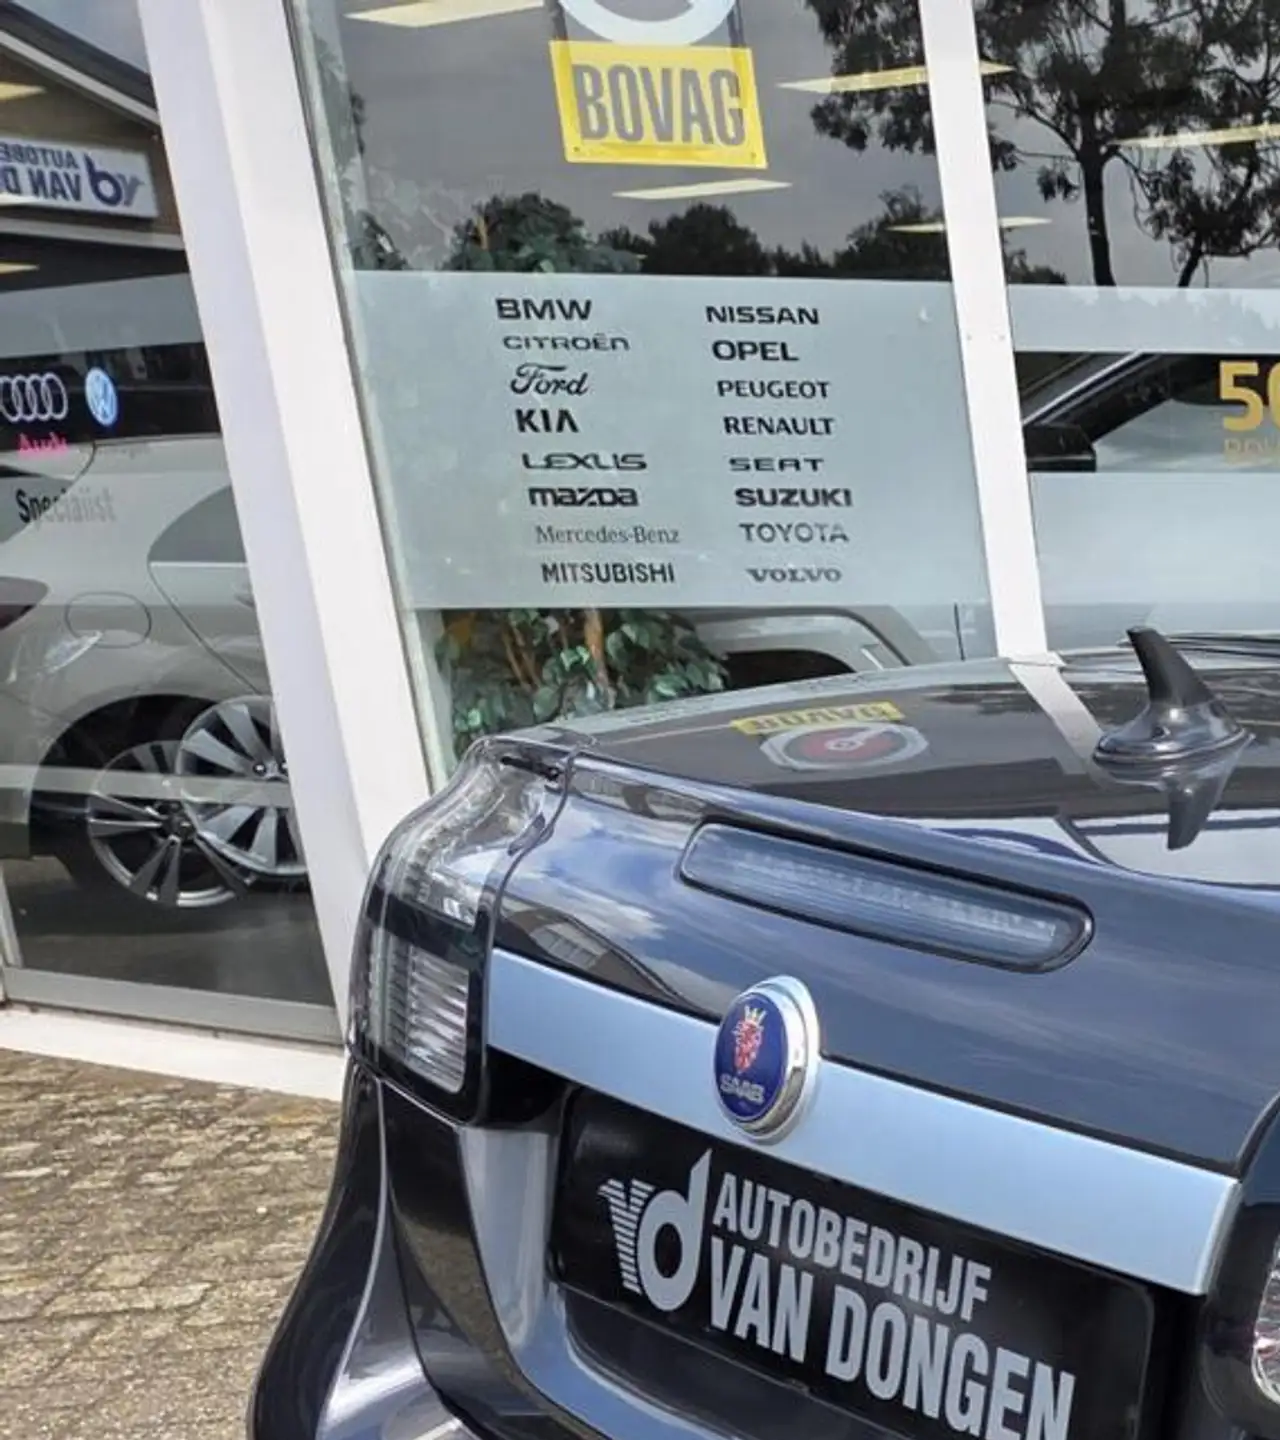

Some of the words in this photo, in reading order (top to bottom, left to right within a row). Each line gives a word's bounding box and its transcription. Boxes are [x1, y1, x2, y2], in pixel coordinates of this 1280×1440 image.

[571, 63, 746, 146] BOVAG
[495, 298, 592, 321] BMW
[705, 306, 820, 325] NISSAN
[711, 340, 800, 361] OPEL
[510, 362, 589, 396] Ford
[717, 380, 830, 399] PEUGEOT
[515, 408, 580, 434] KIA
[723, 416, 835, 436] RENAULT
[522, 453, 648, 471] LEXUS
[728, 457, 825, 472] SEAT
[735, 487, 854, 508] SUZUKI
[535, 525, 680, 544] Mercedes-Benz
[739, 522, 850, 543] TOYOTA
[541, 562, 676, 583] MITSUBISHI
[746, 567, 842, 582] VOLVO
[711, 1171, 992, 1322] AUTOBEDRIJF
[710, 1236, 815, 1363] VAN
